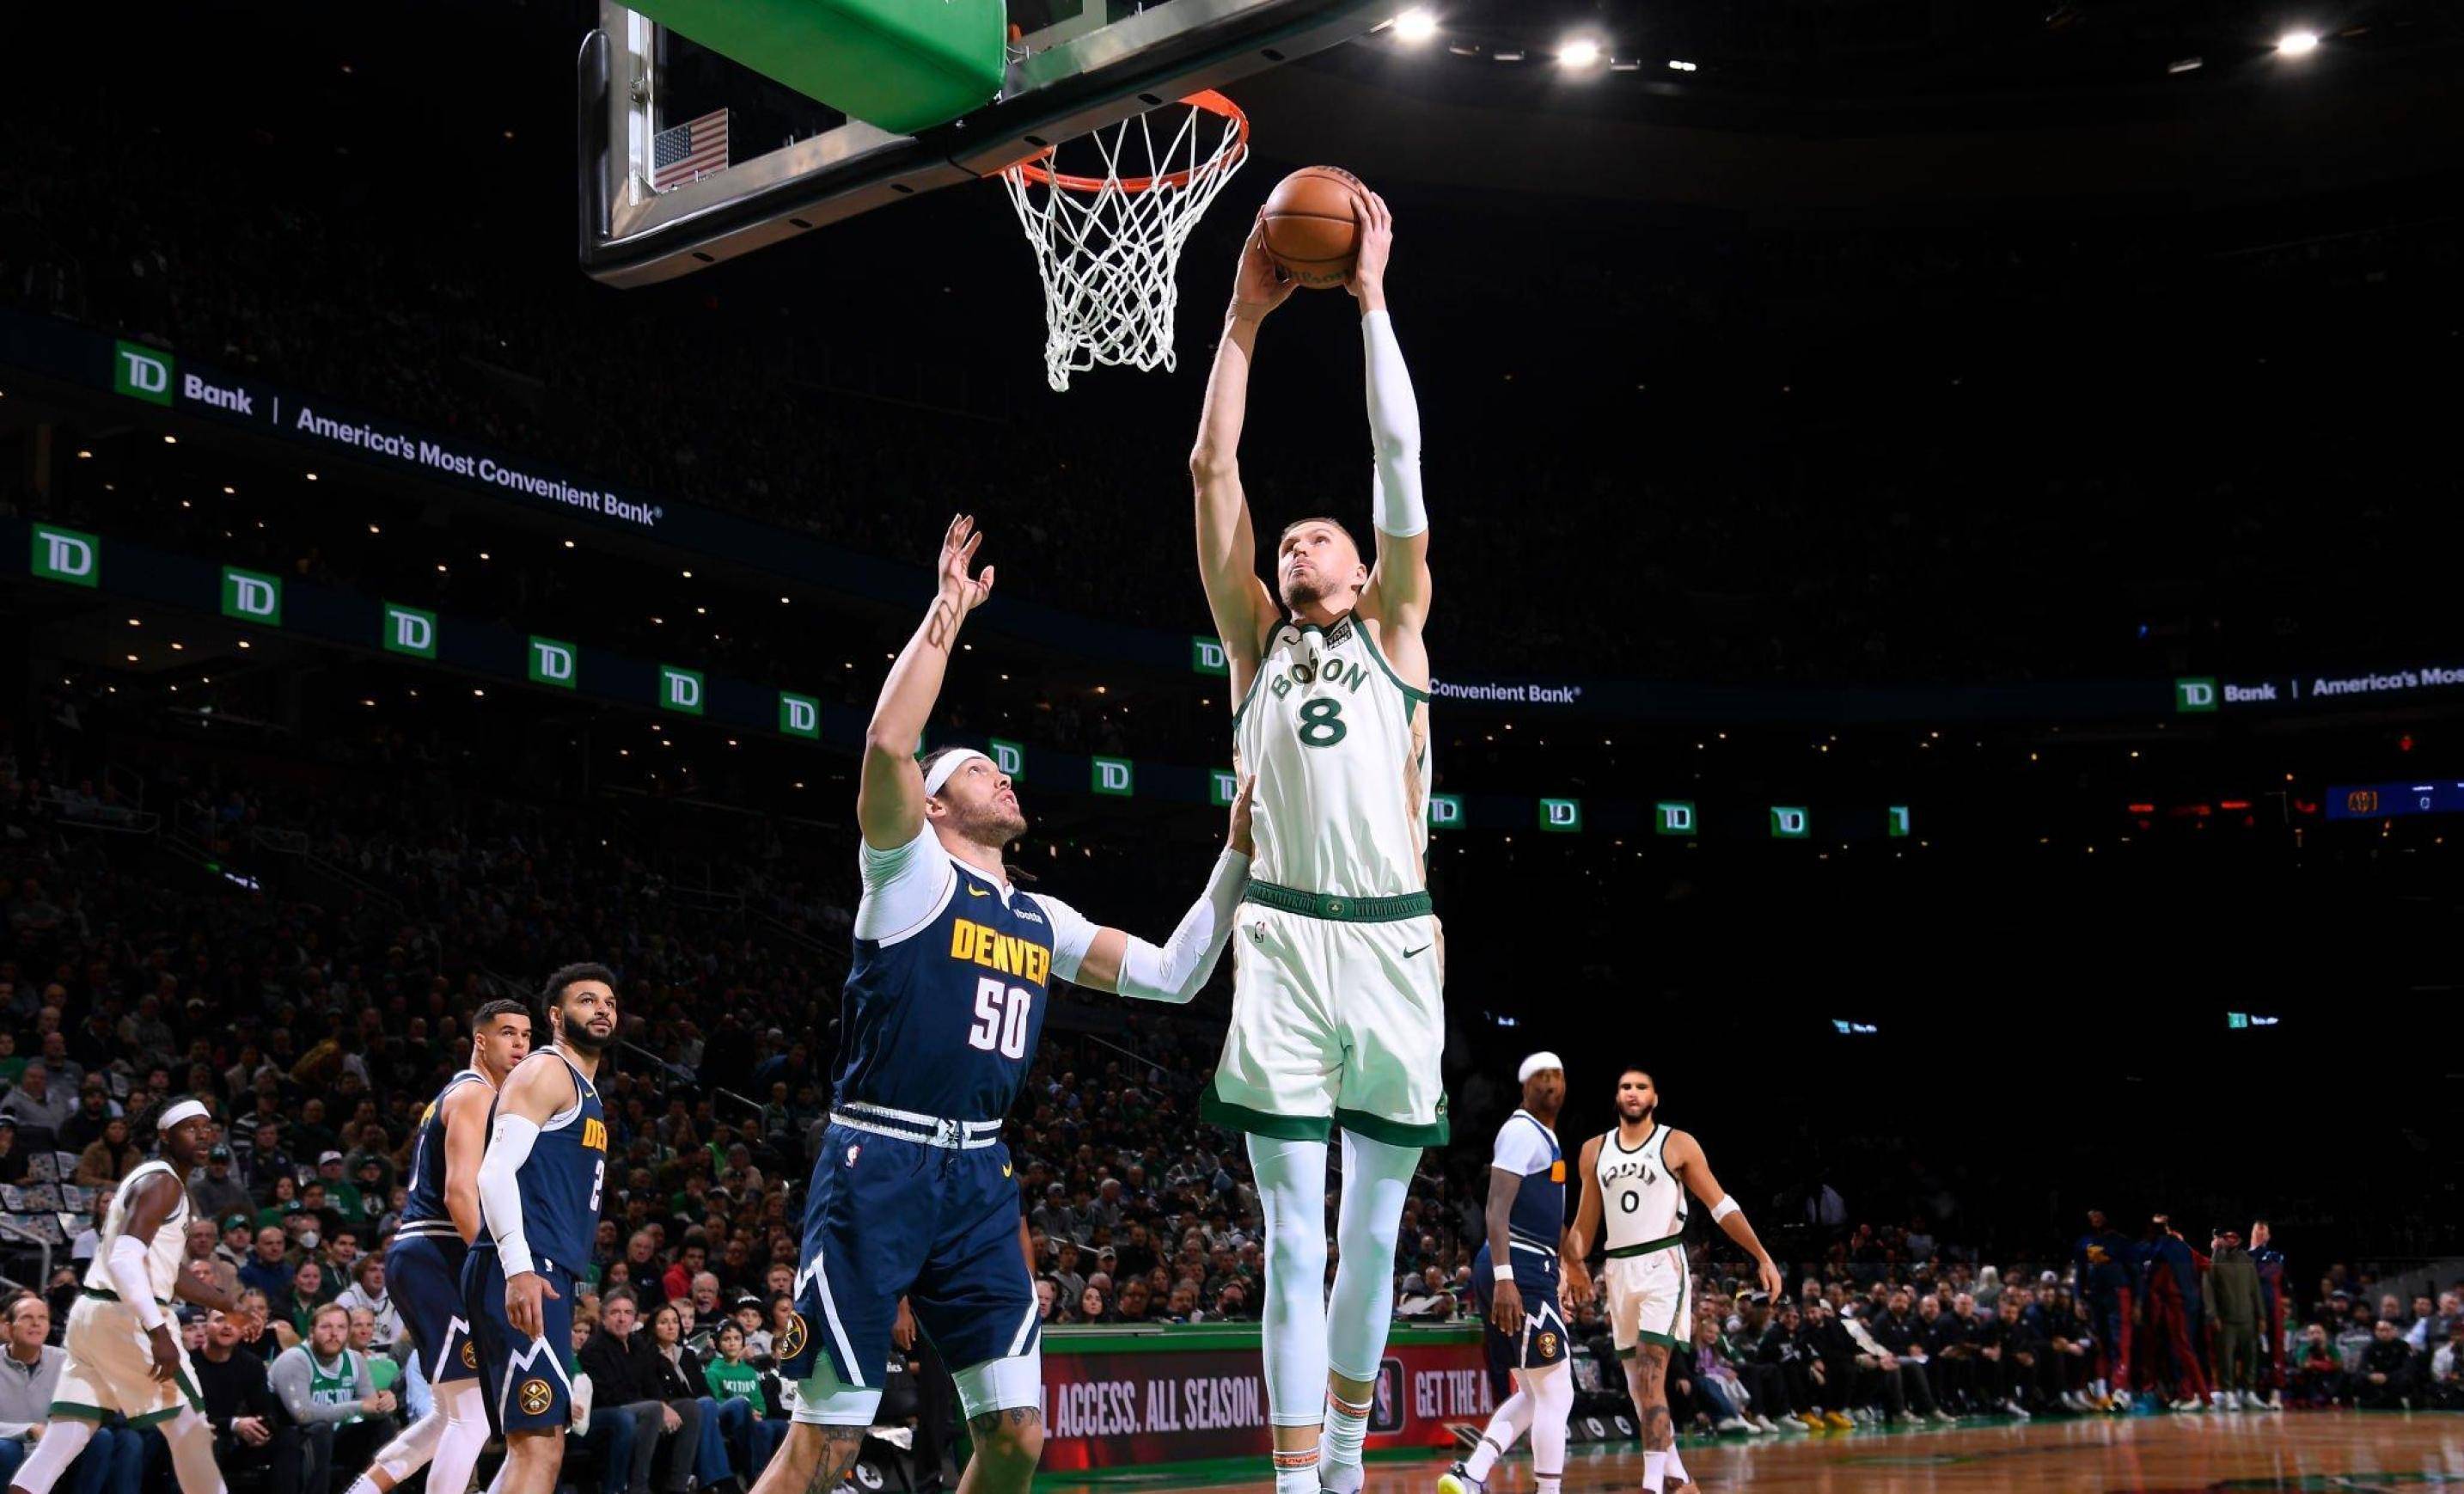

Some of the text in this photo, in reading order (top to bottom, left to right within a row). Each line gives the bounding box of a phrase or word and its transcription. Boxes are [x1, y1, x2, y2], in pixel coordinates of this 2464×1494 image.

[122, 352, 167, 393] TD
[184, 374, 253, 415] Bank
[297, 407, 415, 460] America's
[419, 441, 475, 477] Most
[479, 458, 600, 511] Convenient
[40, 532, 92, 576] TD
[229, 574, 275, 615] TD
[389, 610, 431, 649] TD
[534, 642, 572, 679] TD
[1196, 642, 1225, 667] TD
[1271, 647, 1368, 701] BOON
[664, 671, 699, 706] TD
[1430, 677, 1525, 701] Convenient
[2180, 683, 2213, 705] TD
[2224, 683, 2276, 702] Bank
[2313, 671, 2418, 696] America's
[783, 697, 816, 731] TD
[1299, 698, 1347, 748] 8
[993, 744, 1020, 774] TD
[1096, 761, 1129, 790] TD
[951, 918, 1051, 988] DENVER
[968, 977, 1031, 1060] 50
[1621, 1191, 1639, 1214] 0
[1056, 1381, 1141, 1438] ACCESS.
[1146, 1379, 1181, 1432] ALL
[1184, 1376, 1264, 1430] SEASON.
[1415, 1370, 1445, 1418] GET
[1446, 1368, 1477, 1416] THE
